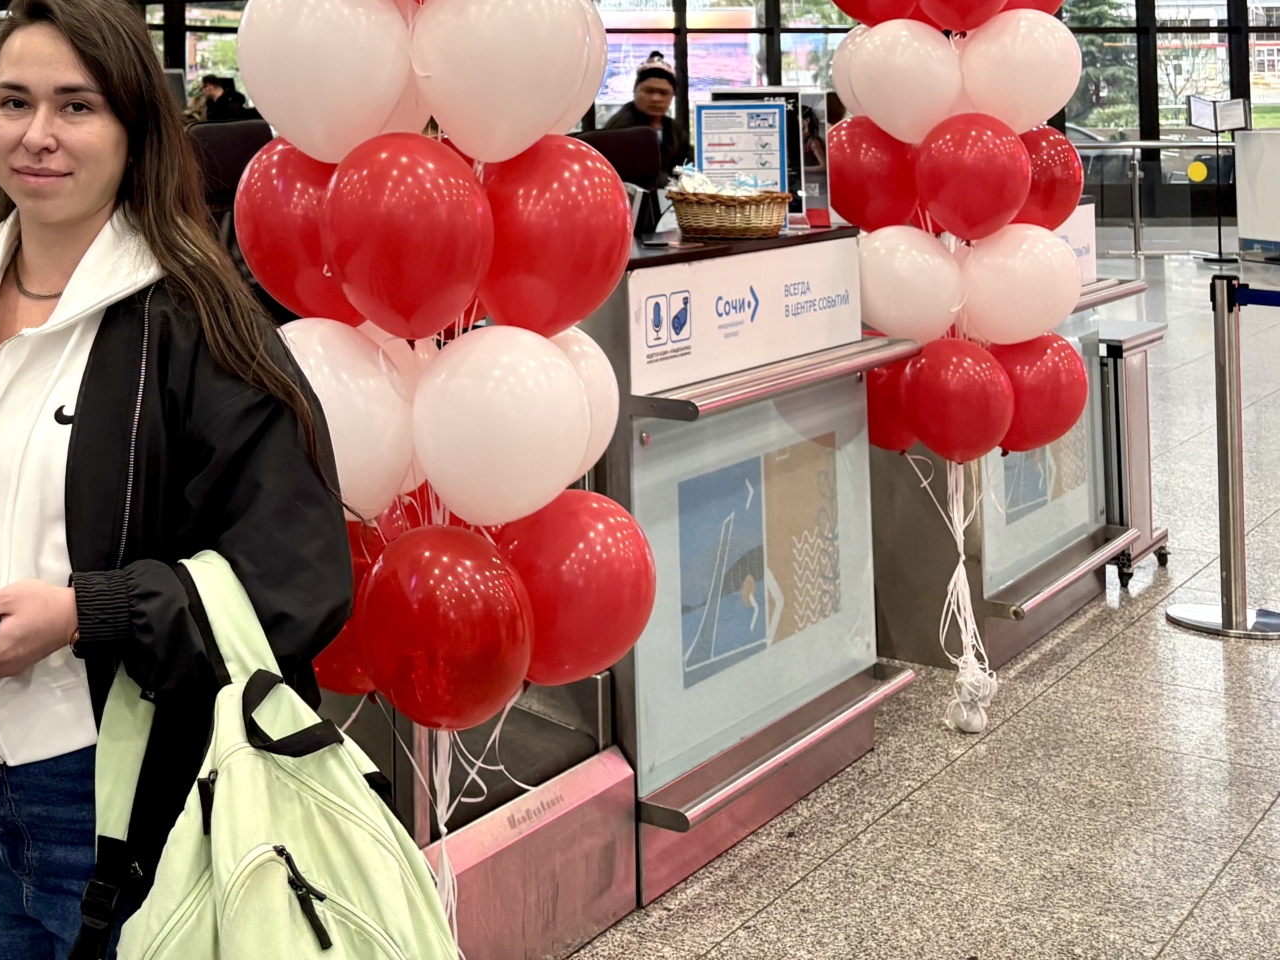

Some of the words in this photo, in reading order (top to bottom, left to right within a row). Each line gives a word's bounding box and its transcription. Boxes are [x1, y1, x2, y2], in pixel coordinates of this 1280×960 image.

[784, 281, 811, 297] ВСЕГДА
[715, 295, 745, 318] Сочи
[784, 304, 790, 318] В
[791, 298, 817, 317] ЦЕНТРЕ
[818, 289, 850, 310] СОБЫТИЙ
